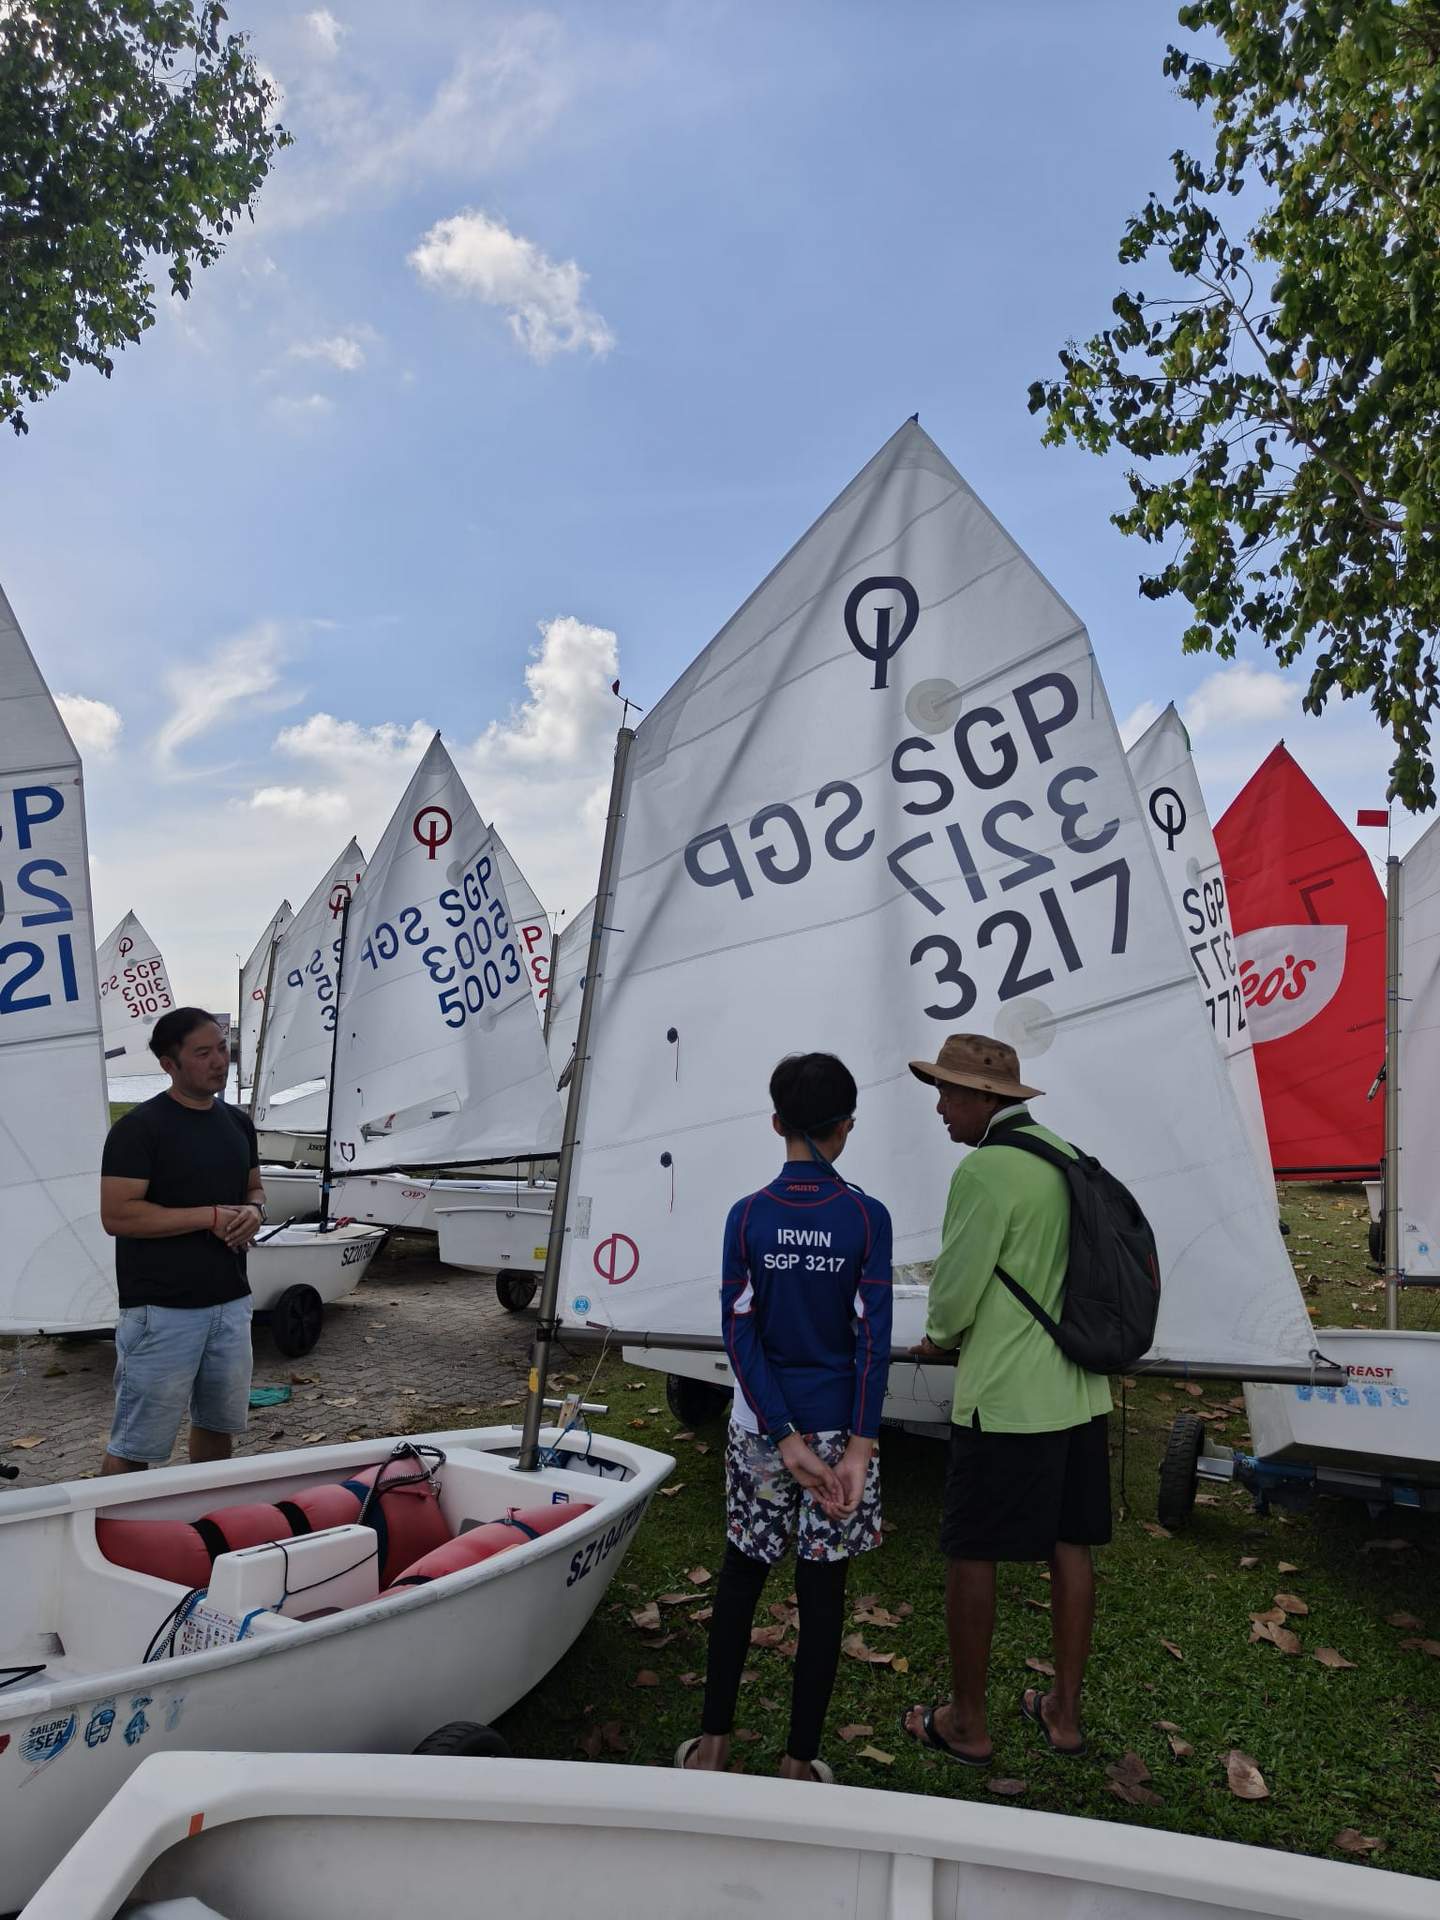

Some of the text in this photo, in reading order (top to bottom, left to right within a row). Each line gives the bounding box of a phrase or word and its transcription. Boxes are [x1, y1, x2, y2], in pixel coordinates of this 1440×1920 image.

[890, 671, 1079, 816] SGP
[0, 786, 65, 850] P
[438, 856, 492, 928] SGP
[1182, 877, 1224, 935] SGP
[519, 925, 543, 954] P
[909, 857, 1131, 1021] 3217
[123, 960, 161, 983] SGP
[438, 943, 521, 1029] 5003
[1239, 954, 1317, 1009] eo's
[127, 993, 172, 1018] 3103
[777, 1228, 832, 1248] IRWIN
[763, 1253, 846, 1273] SGP 3217
[1345, 1364, 1394, 1379] REAST
[28, 1717, 70, 1738] SAILORS
[34, 1732, 67, 1752] SEA
